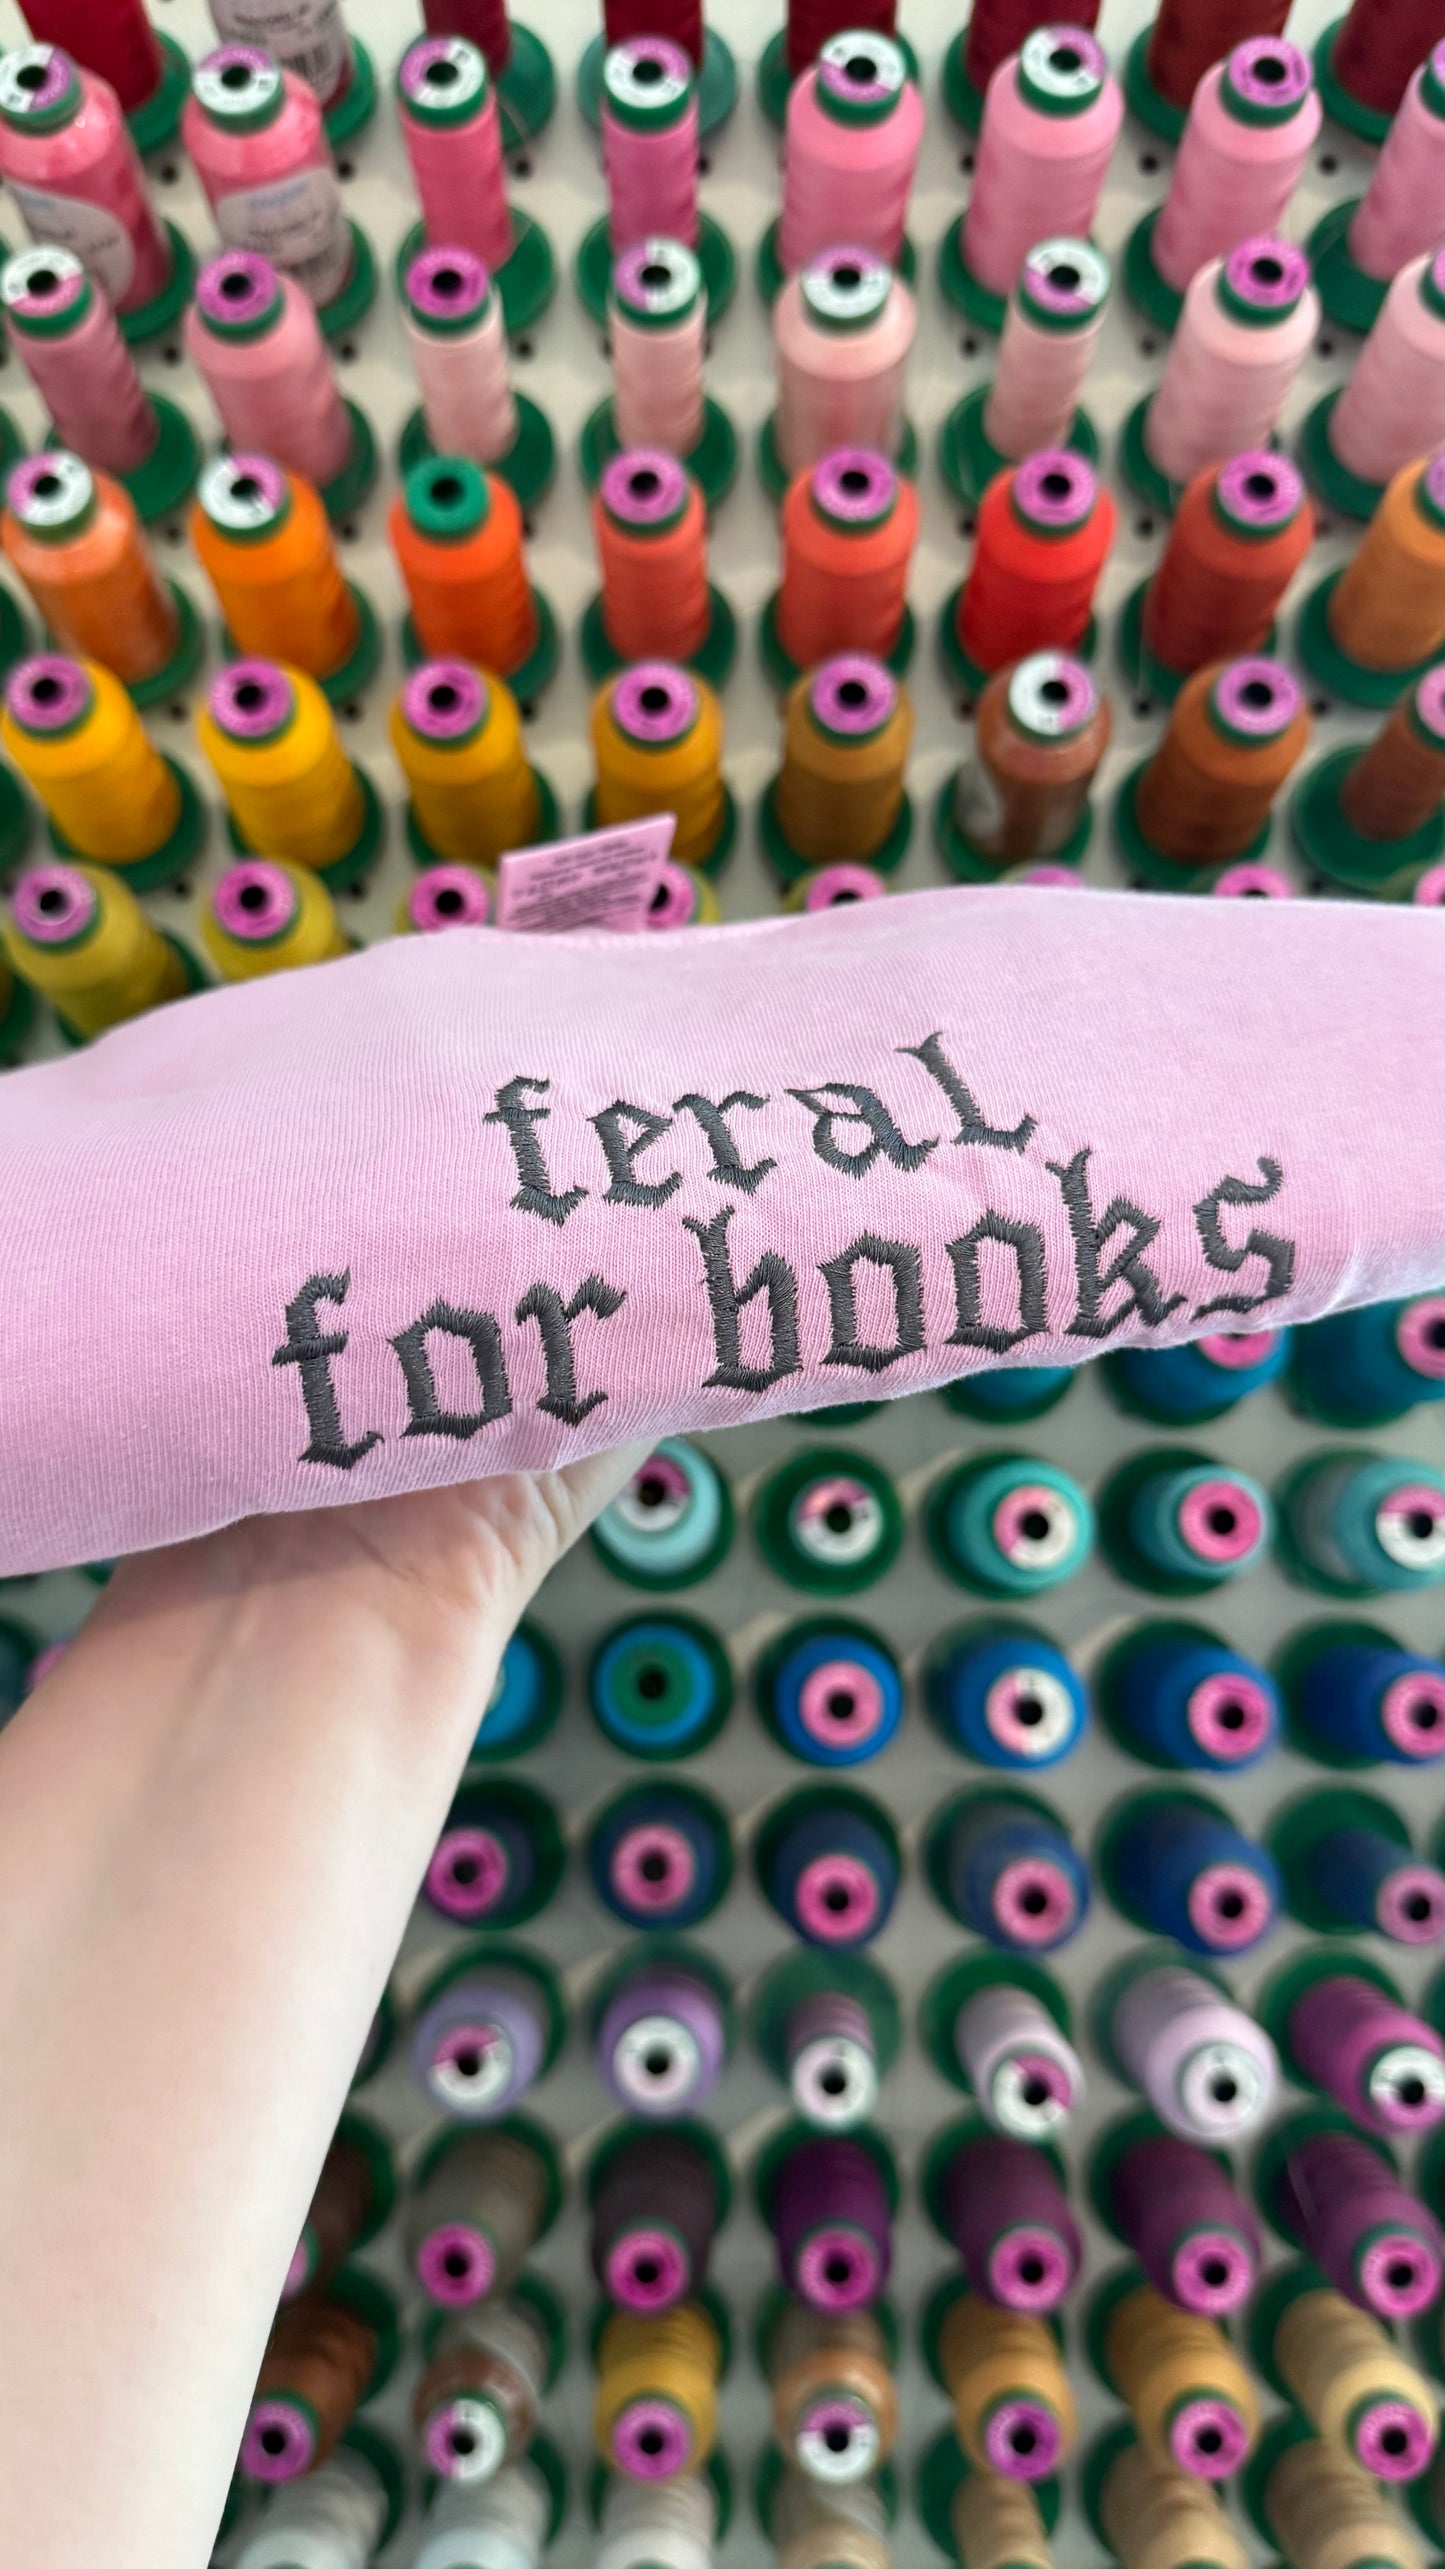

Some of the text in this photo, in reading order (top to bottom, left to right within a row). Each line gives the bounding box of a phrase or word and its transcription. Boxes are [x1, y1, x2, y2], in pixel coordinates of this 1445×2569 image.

[484, 1032, 1038, 1228] feral
[272, 1146, 1296, 1472] for books
